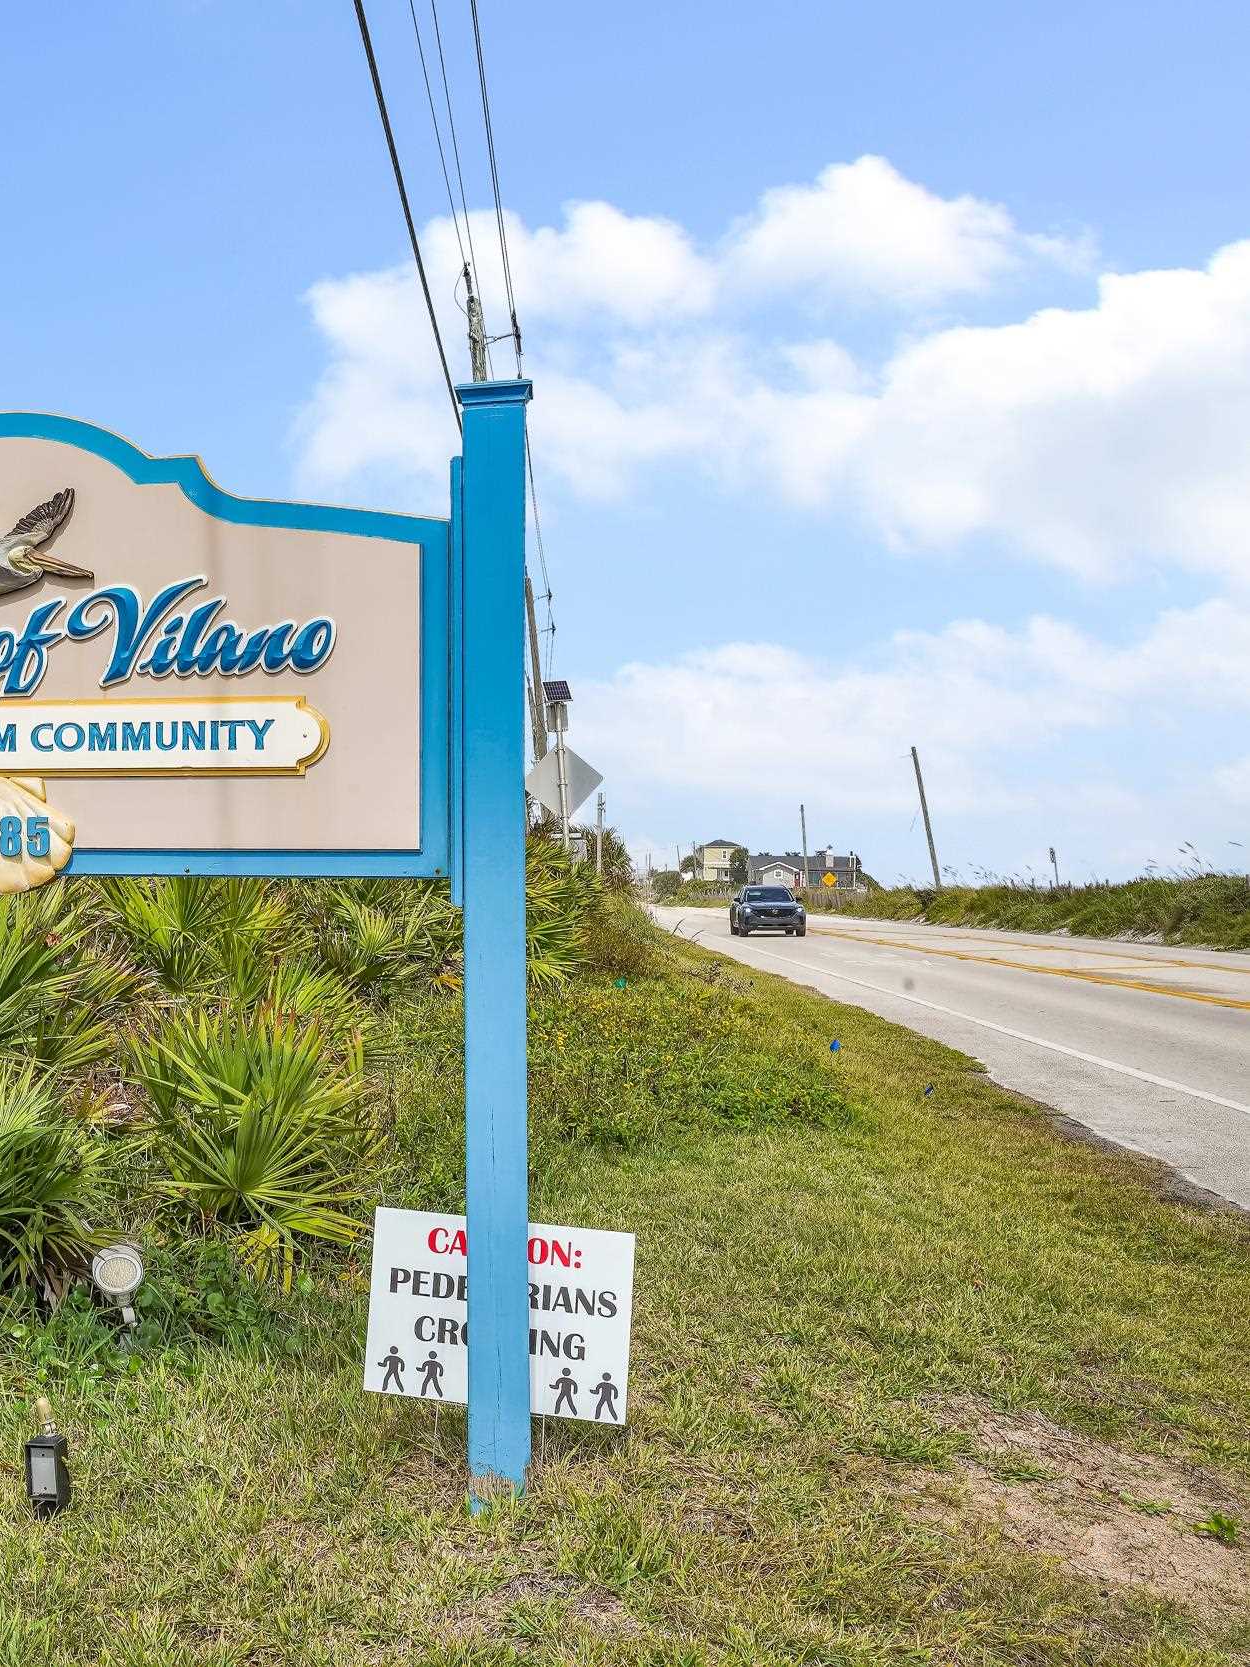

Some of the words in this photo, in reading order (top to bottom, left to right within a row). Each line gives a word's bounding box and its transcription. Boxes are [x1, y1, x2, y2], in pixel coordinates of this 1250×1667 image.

[65, 576, 335, 686] Vilano
[30, 719, 275, 752] COMMUNITY
[427, 1227, 582, 1269] CAON:
[414, 1315, 586, 1361] CRING
